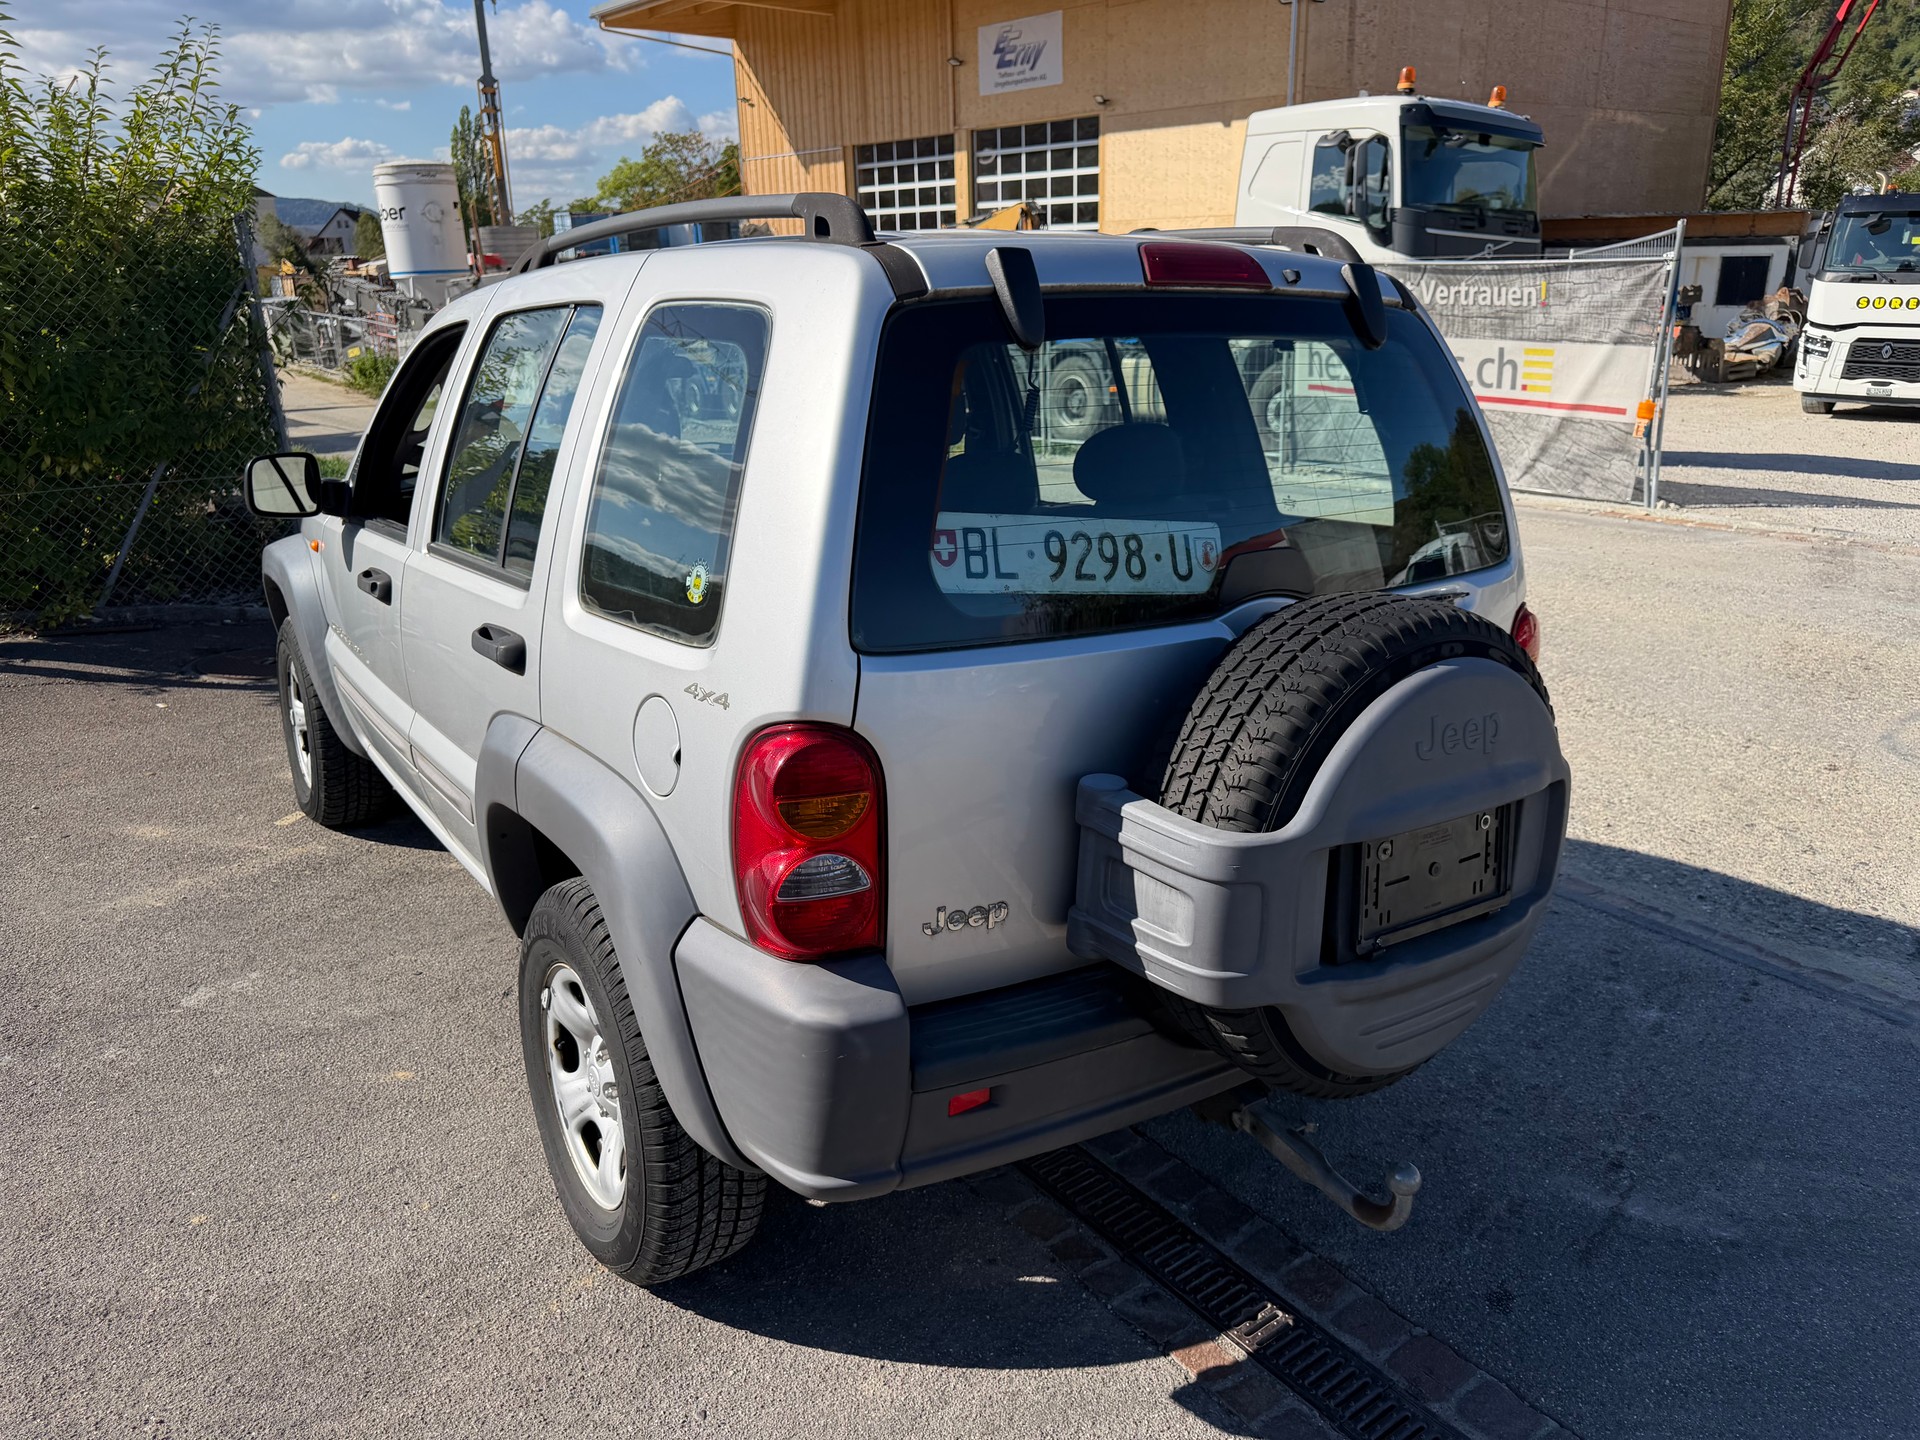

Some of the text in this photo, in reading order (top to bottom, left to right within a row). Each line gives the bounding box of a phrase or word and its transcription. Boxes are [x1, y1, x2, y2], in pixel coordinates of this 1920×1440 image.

[1420, 280, 1547, 307] Vertrauen!
[1416, 712, 1498, 761] Jeep
[922, 900, 1008, 936] Jeep
